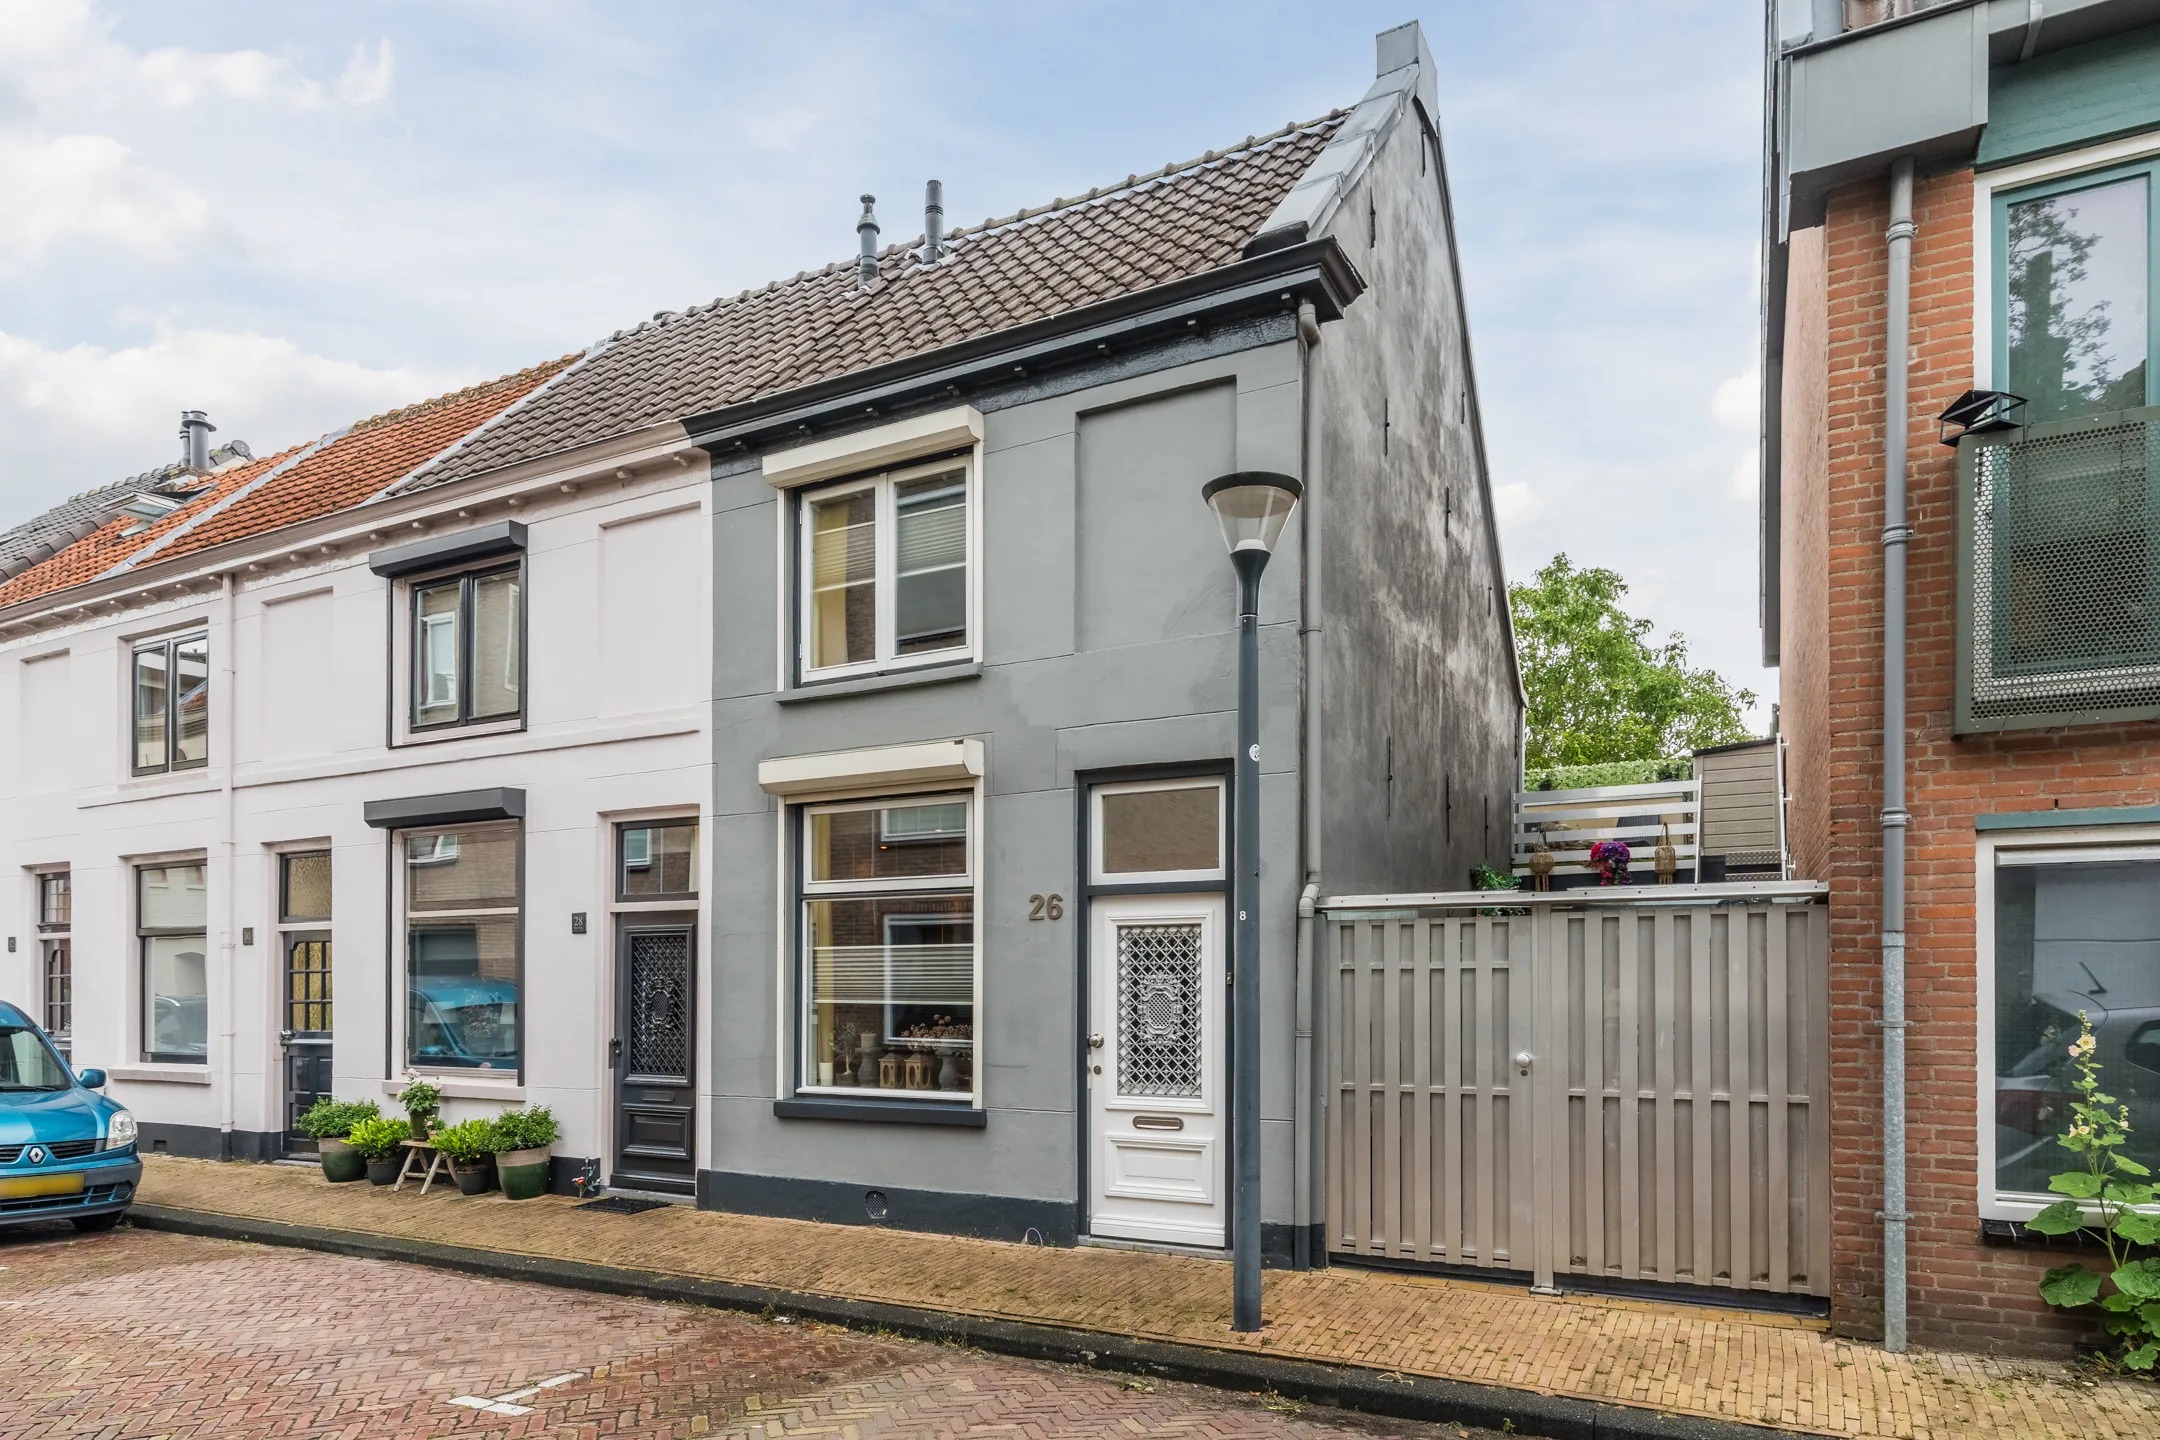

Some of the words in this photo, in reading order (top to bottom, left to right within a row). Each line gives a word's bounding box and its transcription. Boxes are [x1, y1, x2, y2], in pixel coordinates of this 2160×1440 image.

[1029, 894, 1063, 920] 26
[1240, 911, 1246, 920] 8
[574, 916, 583, 925] 28
